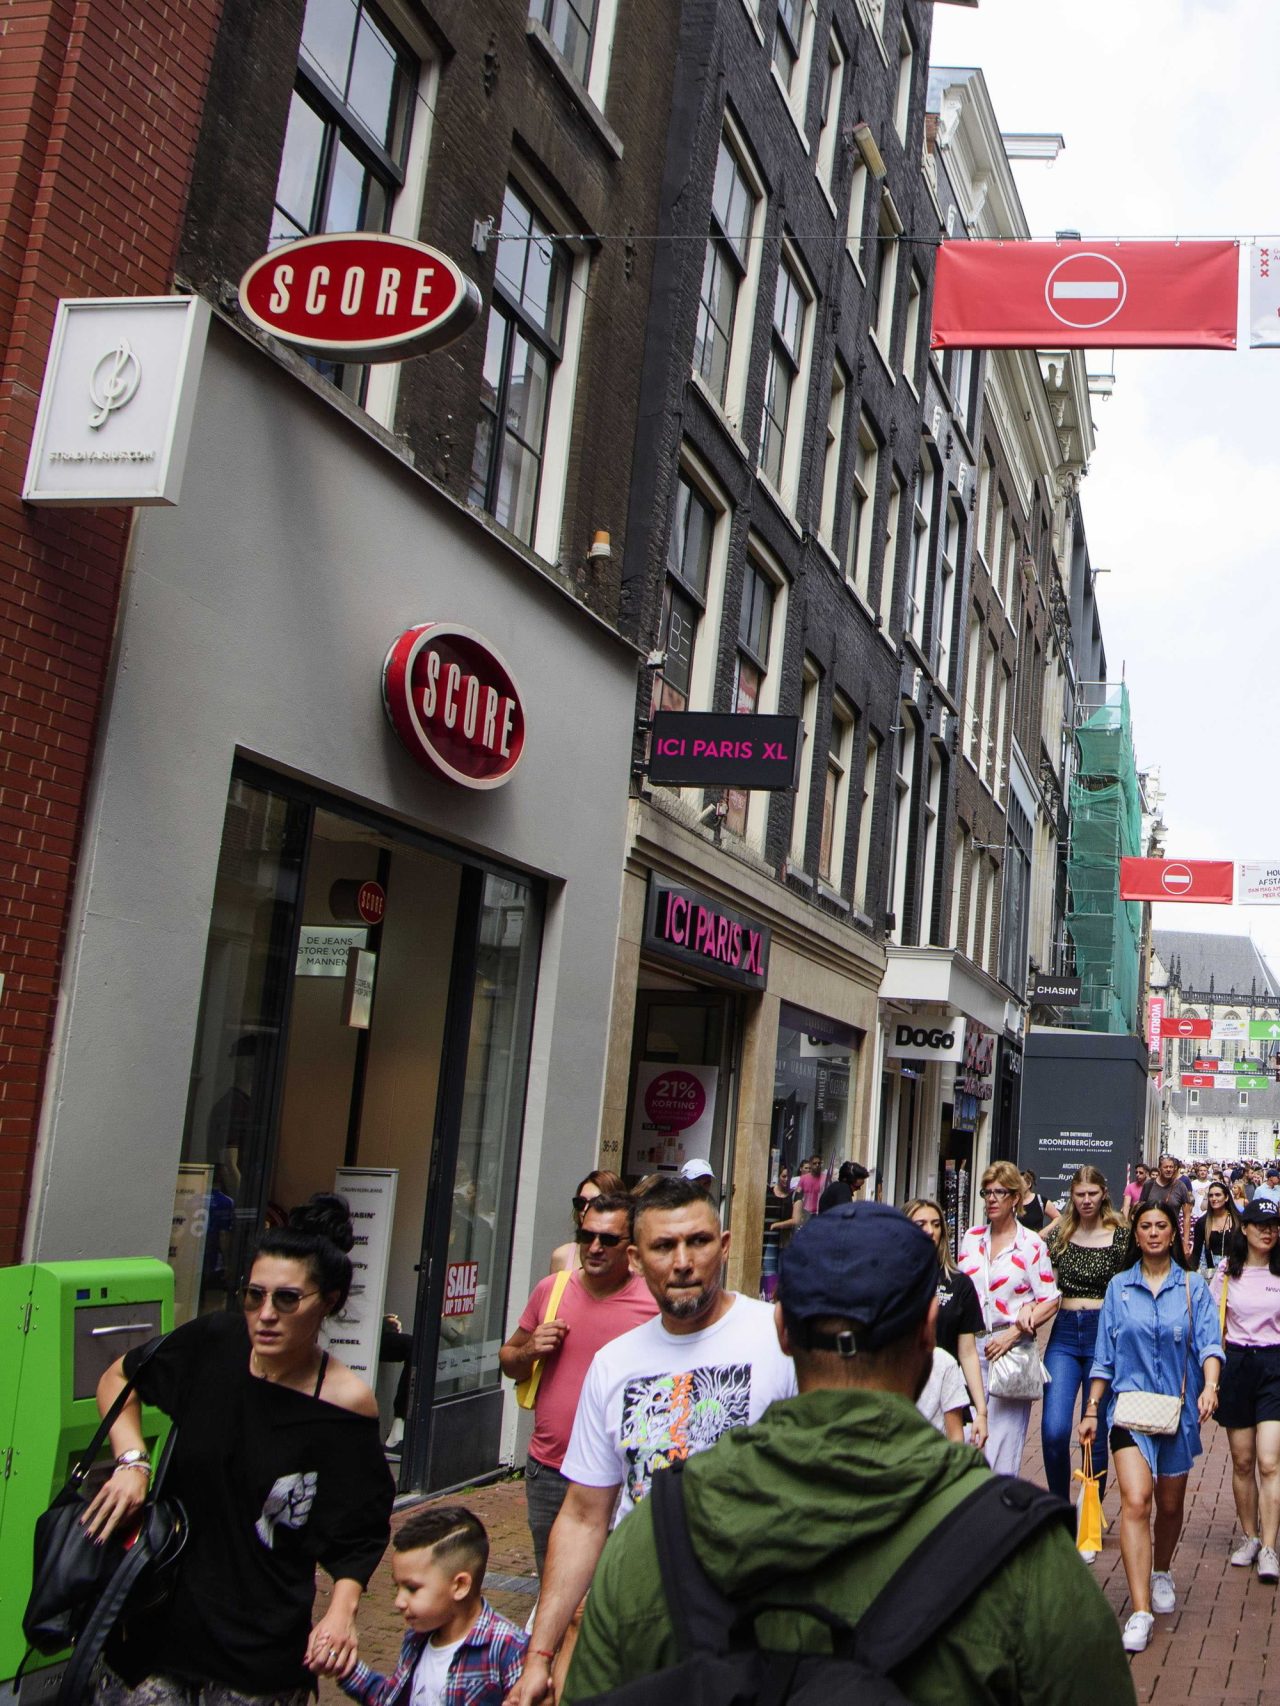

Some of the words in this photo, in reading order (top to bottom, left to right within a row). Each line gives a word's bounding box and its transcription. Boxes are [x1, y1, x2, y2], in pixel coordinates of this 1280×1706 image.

[268, 264, 435, 317] SCORE
[423, 650, 517, 760] SCORE
[656, 738, 686, 757] ICI
[692, 739, 753, 759] PARIS
[762, 742, 788, 760] XL
[361, 890, 384, 914] SCORE
[306, 936, 320, 945] DE
[321, 936, 353, 946] JEANS
[664, 890, 692, 947] ICI
[694, 905, 743, 967] PARIS
[745, 927, 765, 977] XL
[298, 946, 329, 956] STORE
[306, 957, 348, 967] MANNEN
[1151, 1003, 1161, 1034] WORLD
[656, 1080, 696, 1099] 21%
[447, 1264, 478, 1299] SALE
[445, 1299, 454, 1314] UP
[454, 1298, 462, 1313] TO
[462, 1297, 474, 1312] 70%
